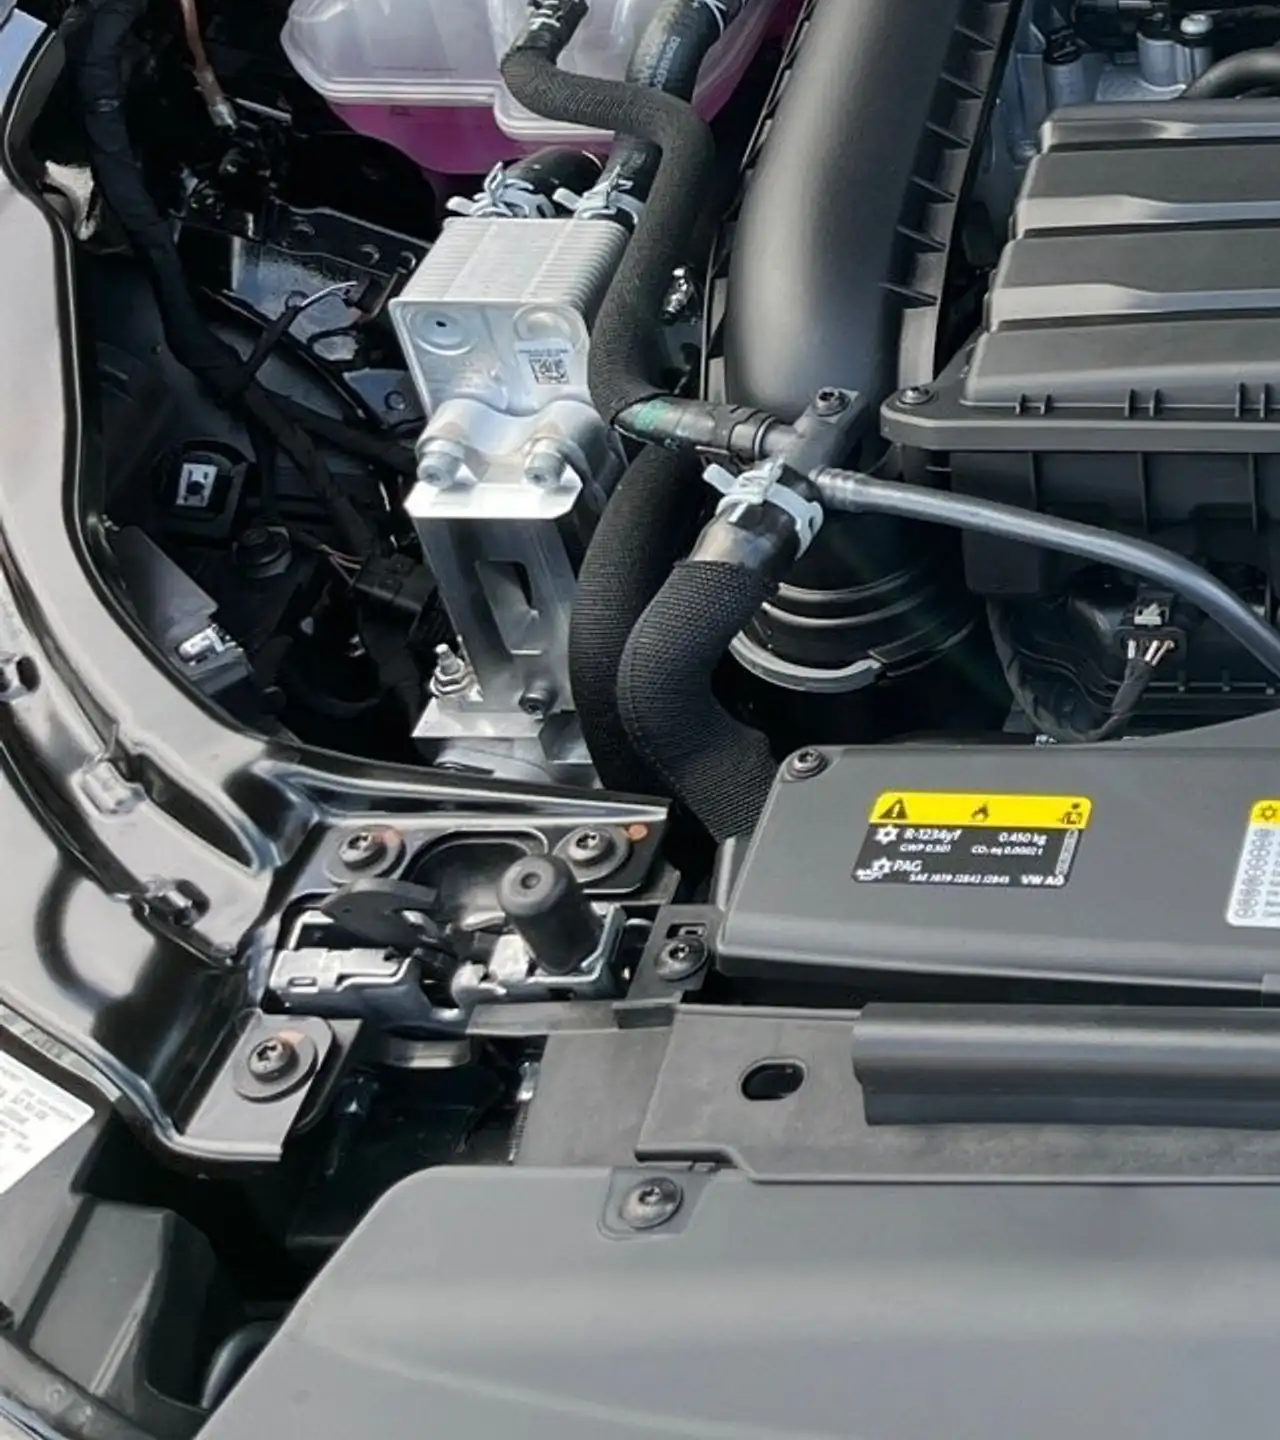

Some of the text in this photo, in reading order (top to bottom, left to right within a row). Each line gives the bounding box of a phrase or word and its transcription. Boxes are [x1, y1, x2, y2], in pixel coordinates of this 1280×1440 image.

[1033, 833, 1048, 846] kg
[892, 859, 923, 872] PAG
[1020, 874, 1044, 885] VW
